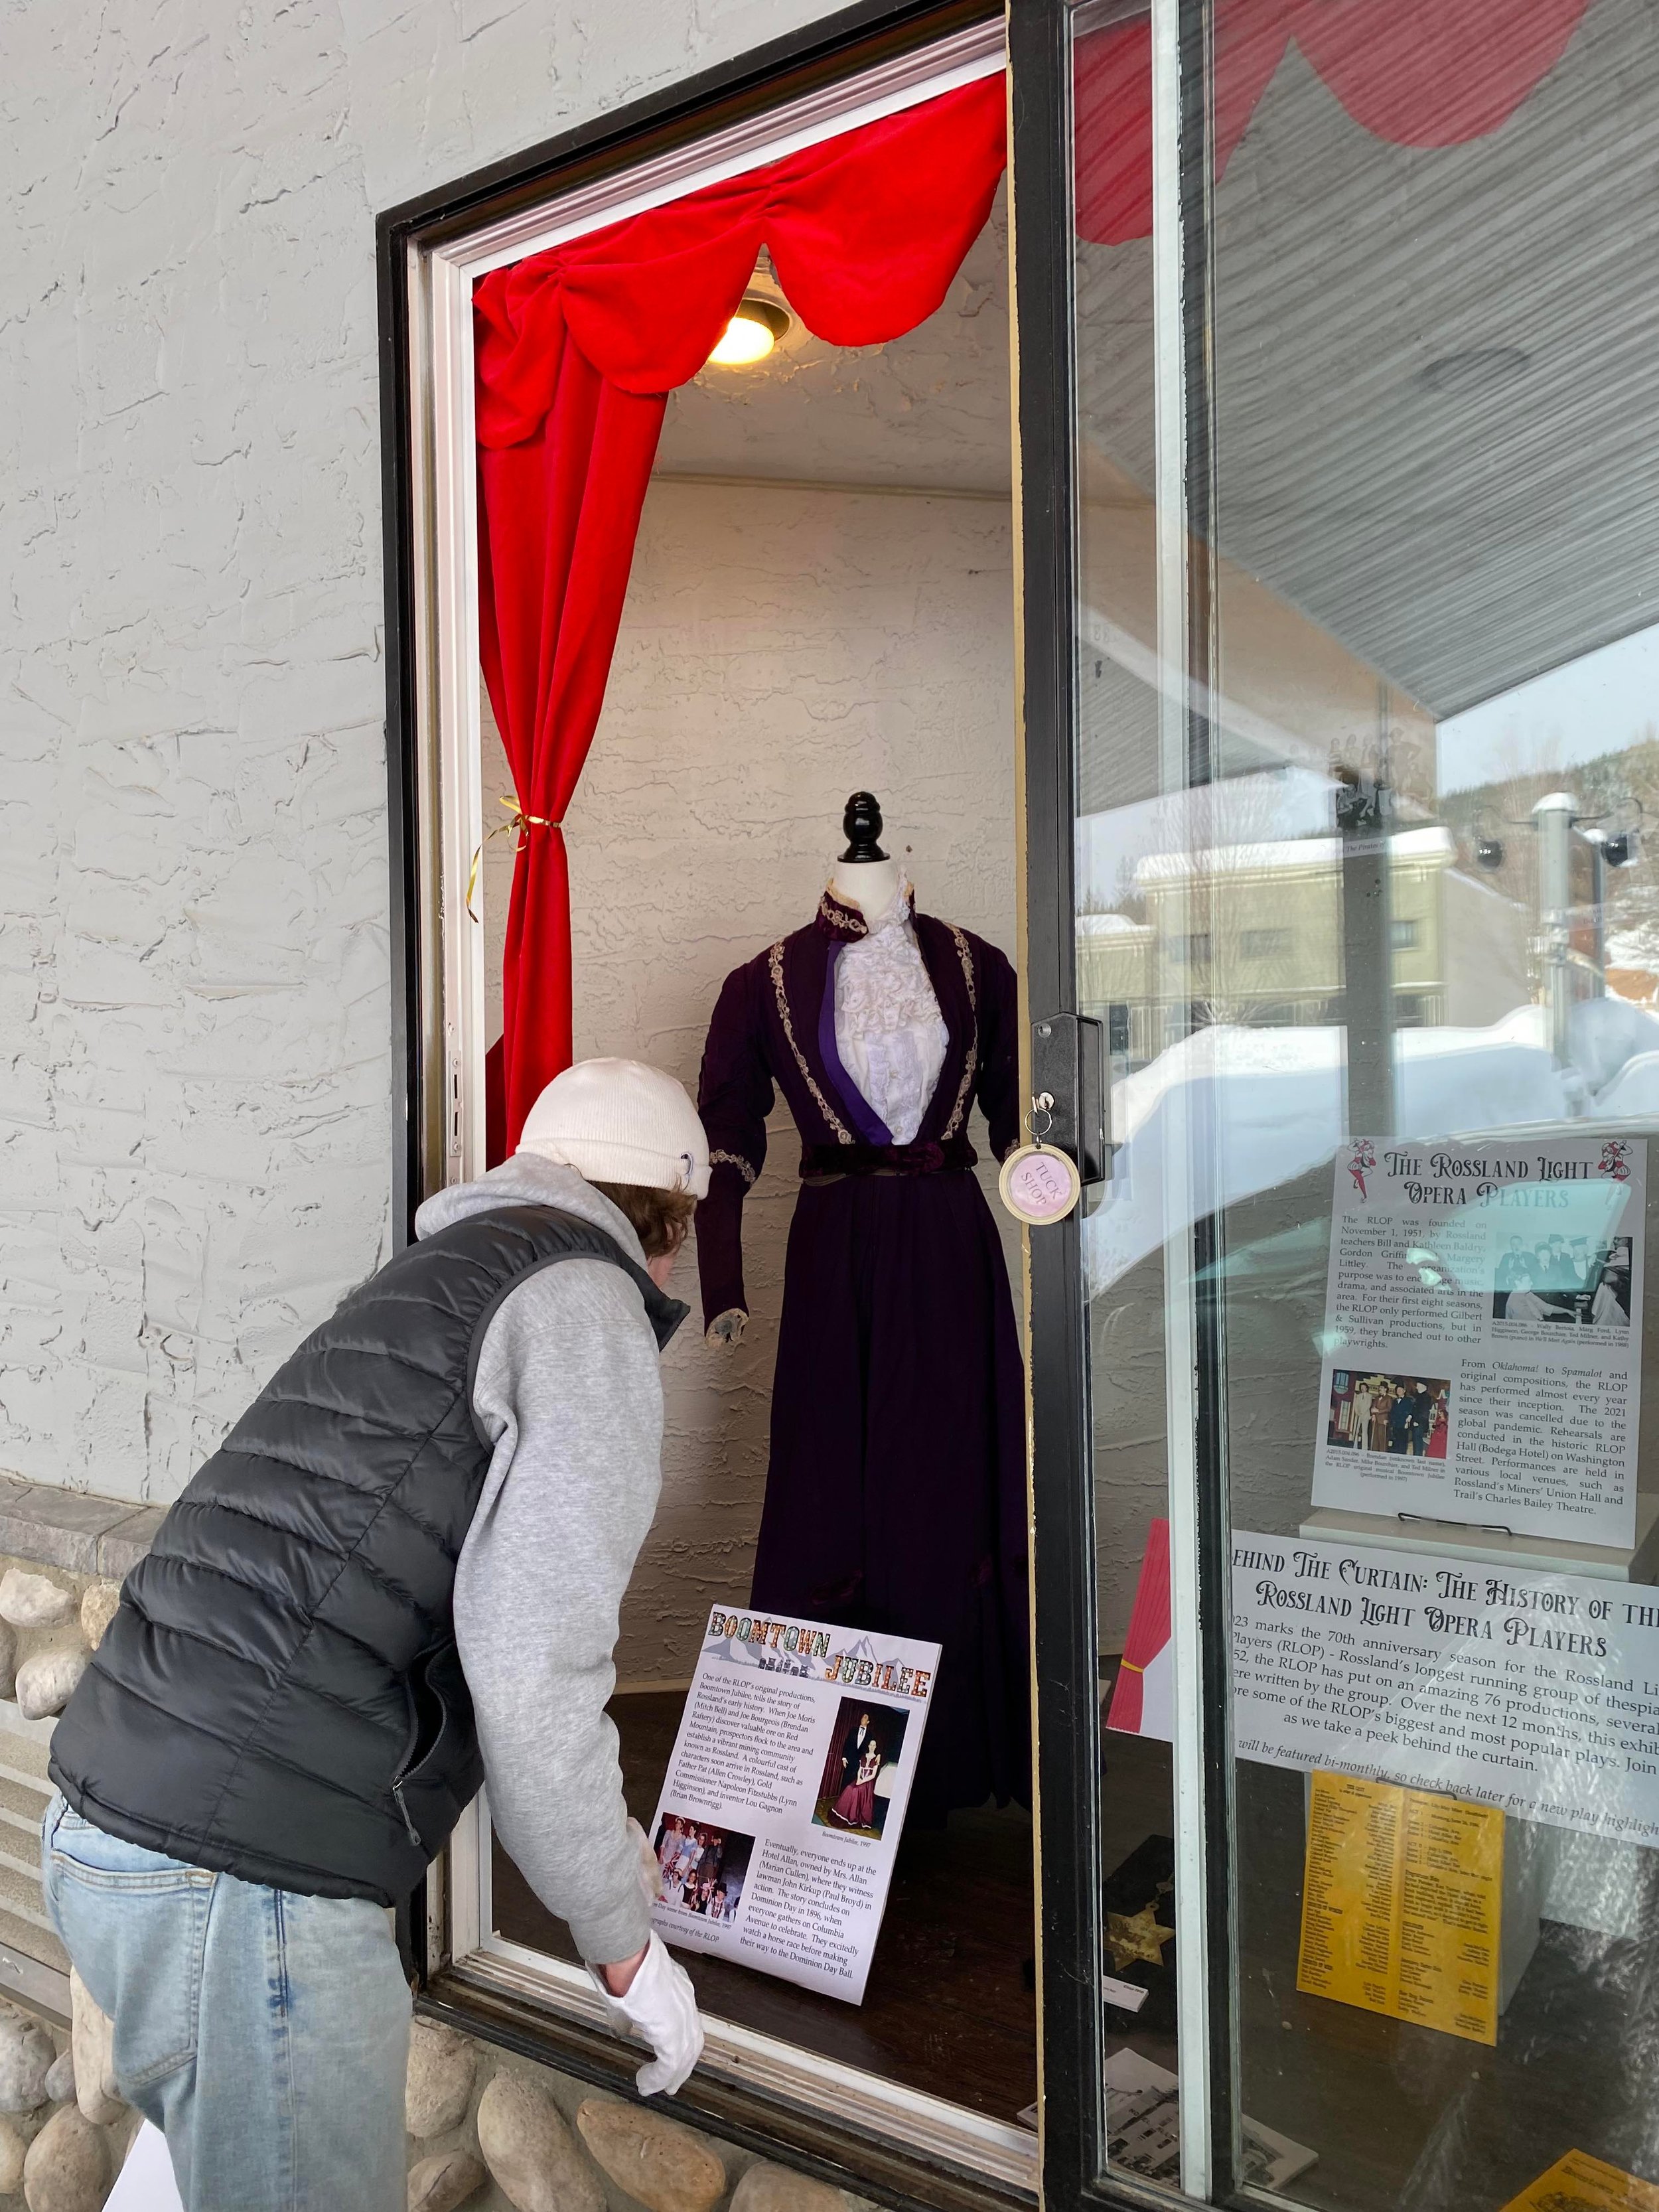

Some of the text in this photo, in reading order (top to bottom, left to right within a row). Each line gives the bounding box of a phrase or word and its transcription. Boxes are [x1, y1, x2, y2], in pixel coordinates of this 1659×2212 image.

[1021, 1172, 1046, 1204] SHOP
[1036, 1161, 1062, 1199] TUCK
[1341, 1226, 1387, 1236] November
[1391, 1228, 1398, 1237] 1,
[1404, 1228, 1425, 1238] 1951,
[1336, 1303, 1482, 1321] the RLOP only performed Gilbert
[1362, 1293, 1377, 1302] For
[1379, 1294, 1400, 1303] their
[1402, 1295, 1419, 1305] first
[1421, 1297, 1444, 1309] eight
[1445, 1301, 1483, 1310] seasons,
[1460, 1371, 1628, 1392] original compositions, the RLOP
[1461, 1359, 1628, 1380] From Oklahoma! to Spamalot and
[1457, 1441, 1477, 1451] Hall
[1478, 1443, 1516, 1457] (Bodega
[1519, 1447, 1549, 1461] Hotel)
[1565, 1452, 1625, 1468] Washington
[1453, 1489, 1596, 1514] Trail's Charles Bailey Theatre.
[1454, 1477, 1504, 1491] Rossland's
[1546, 1487, 1577, 1500] Union
[1580, 1491, 1601, 1503] Hall
[1604, 1496, 1623, 1505] and
[1232, 1549, 1285, 1573] EHIND
[708, 1611, 831, 1657] BOOMTOWN
[1255, 1621, 1294, 1635] marks
[1301, 1626, 1321, 1639] the
[1328, 1630, 1355, 1646] 70th
[1362, 1639, 1442, 1663] anniversary
[1450, 1651, 1496, 1669] season
[1504, 1659, 1526, 1674] for
[1534, 1664, 1556, 1679] the
[1565, 1669, 1633, 1692] Rossland
[702, 1672, 715, 1681] One
[721, 1676, 732, 1685] the
[732, 1678, 755, 1690] RLOP's
[755, 1684, 778, 1695] original
[778, 1690, 816, 1704] productions,
[825, 1655, 930, 1697] JUBILEE
[1255, 1653, 1274, 1666] the
[1277, 1657, 1317, 1673] RLOP
[1321, 1664, 1343, 1679] has
[1347, 1672, 1372, 1684] put
[1376, 1677, 1392, 1688] on
[1398, 1681, 1414, 1692] an
[1419, 1684, 1480, 1706] amazing
[1484, 1692, 1500, 1707] 76
[1506, 1698, 1600, 1726] productions,
[699, 1681, 731, 1695] Boomtown
[730, 1688, 753, 1701] Jubilee,
[753, 1694, 766, 1702] tells
[766, 1696, 777, 1705] the
[776, 1700, 793, 1710] story
[694, 1701, 713, 1712] (Mitch
[714, 1705, 727, 1716] Bell)
[739, 1711, 751, 1720] Joe
[750, 1713, 780, 1726] Bourgeois
[780, 1720, 809, 1733] (Brendan
[1283, 1714, 1538, 1771] as we take a peek behind the curtain.
[1238, 1739, 1260, 1751] will
[1262, 1741, 1275, 1754] be
[1273, 1745, 1323, 1764] featured
[1324, 1755, 1390, 1781] bi-monthly,
[1394, 1773, 1407, 1784] so
[1409, 1772, 1445, 1790] check
[1445, 1779, 1474, 1796] back
[1476, 1786, 1505, 1803] later
[1504, 1793, 1526, 1808] for
[1540, 1803, 1567, 1818] new
[1569, 1806, 1601, 1825] play
[764, 1838, 799, 1854] Eventually,
[800, 1850, 830, 1863] everyone
[830, 1858, 847, 1868] ends
[847, 1862, 857, 1872] up
[865, 1866, 877, 1876] the
[756, 1870, 872, 1911] lawman John Kirkup (Paul Broyd) in
[751, 1891, 842, 1926] Dominion Day in 1896, when
[740, 1936, 853, 1979] their way to the Dominion Day Ball.
